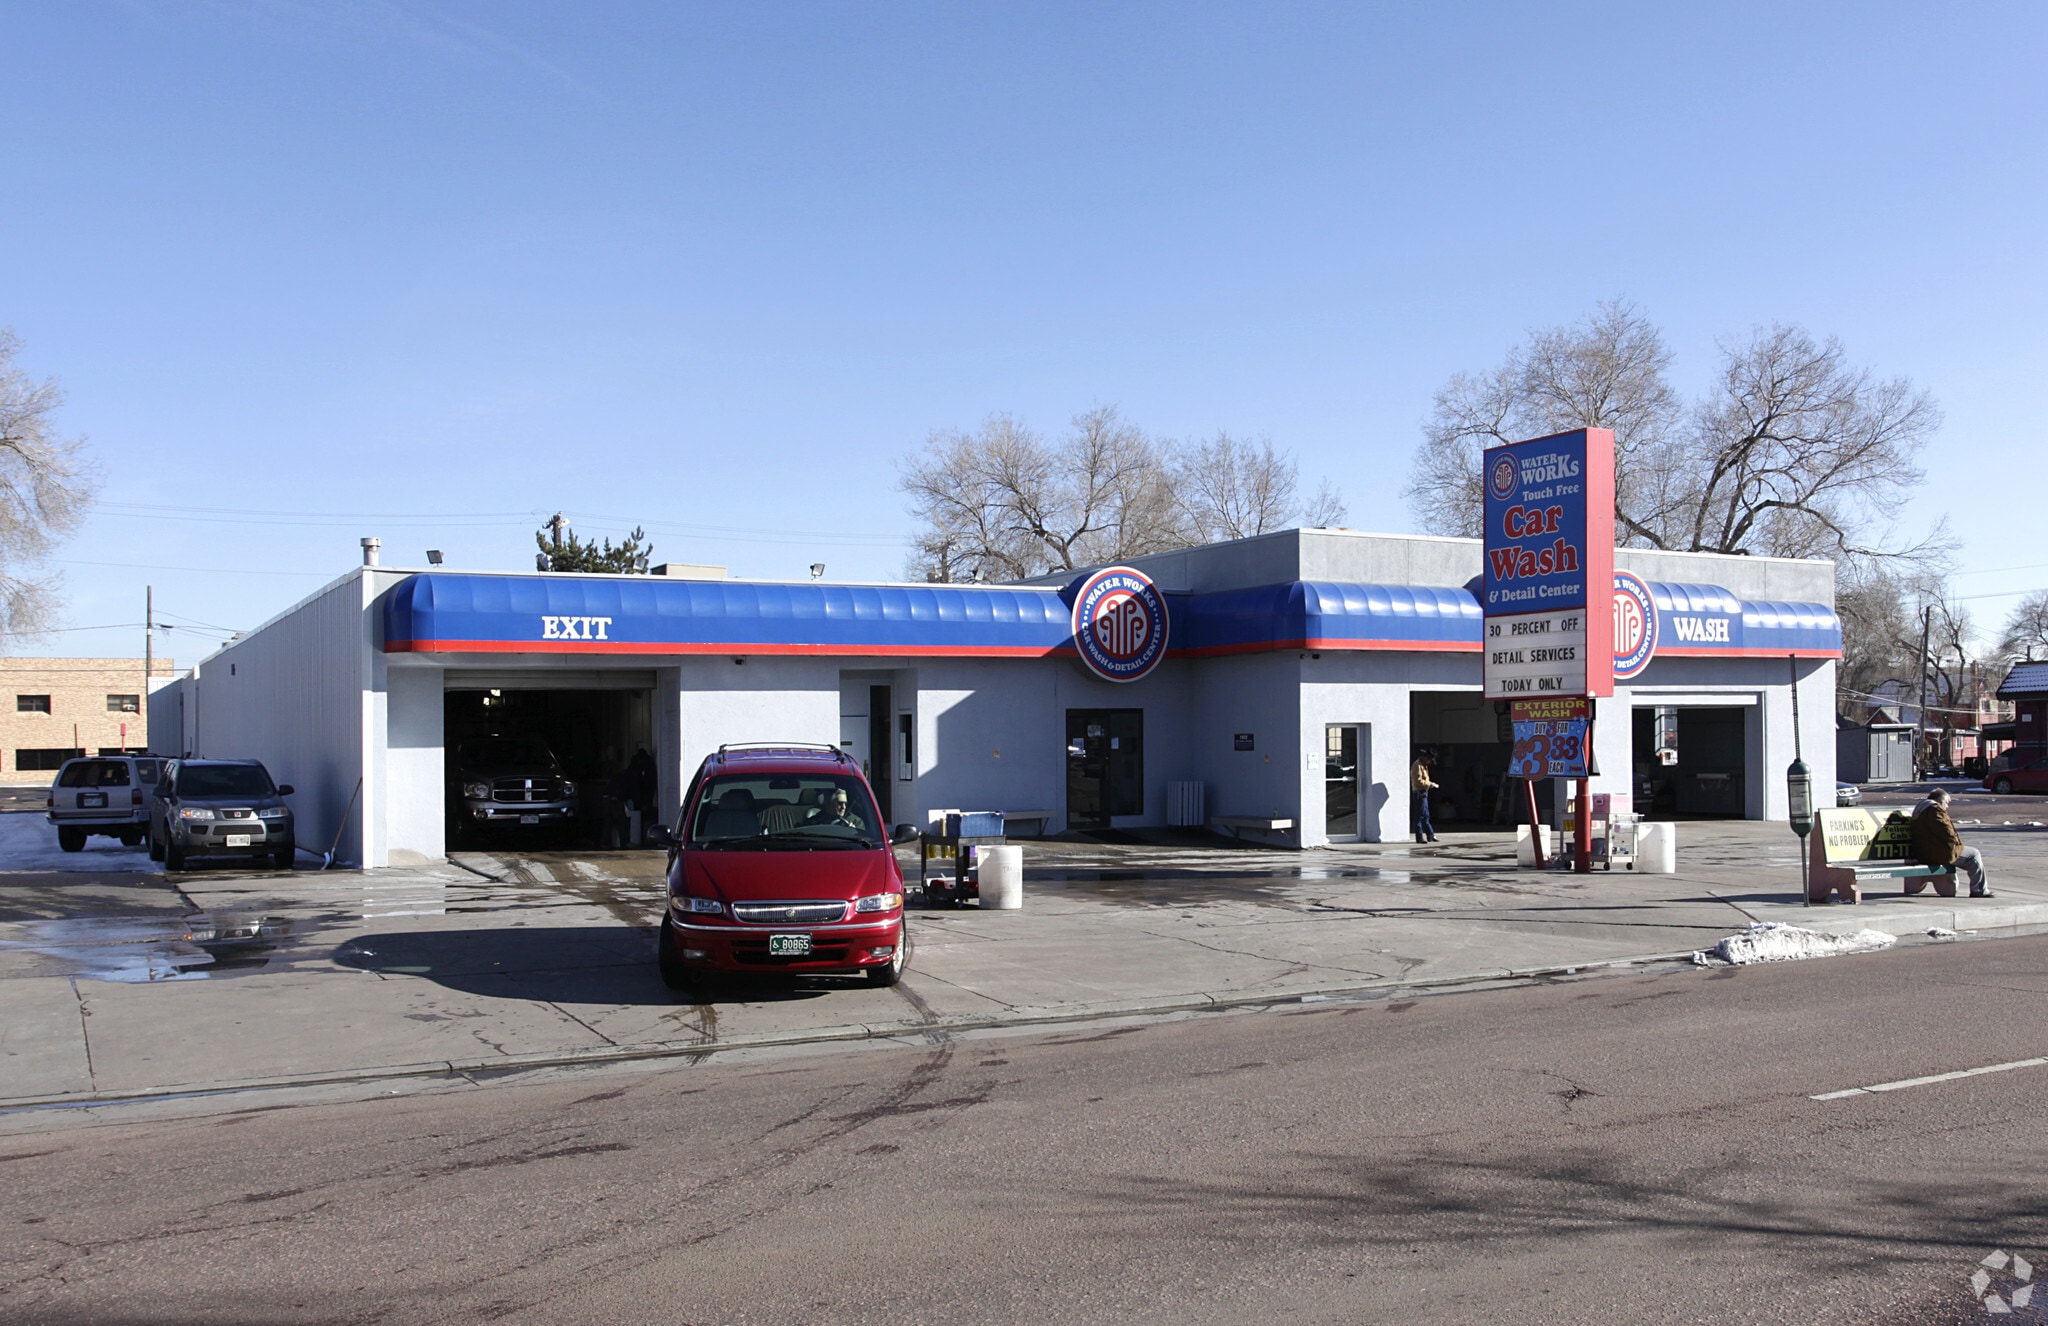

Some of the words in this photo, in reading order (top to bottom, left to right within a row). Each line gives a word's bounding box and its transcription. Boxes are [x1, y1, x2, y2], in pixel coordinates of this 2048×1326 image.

[1521, 453, 1557, 469] WATER
[1523, 487, 1552, 501] Touch
[1556, 484, 1579, 496] Free
[1504, 505, 1563, 539] Car
[1489, 537, 1578, 581] Wash
[1086, 577, 1120, 606] WATER
[1122, 577, 1156, 607] WORKS
[1489, 591, 1498, 603] &
[1502, 587, 1536, 601] Detail
[1539, 584, 1580, 596] Center
[1622, 579, 1648, 608] WORKS
[542, 616, 612, 640] EXIT
[1490, 626, 1500, 636] 30
[1512, 620, 1550, 634] PERCENT
[1562, 618, 1578, 631] OFF
[1673, 617, 1730, 642] WASH
[1082, 622, 1090, 644] CAR
[1088, 642, 1108, 666] WASH
[1108, 662, 1114, 670] &
[1114, 660, 1144, 671] DETAIL
[1143, 624, 1160, 660] CENTER
[1617, 655, 1639, 668] DETAIL
[1638, 622, 1652, 658] CENTER
[1493, 651, 1524, 664] DETAIL
[1531, 648, 1574, 662] SERVICES
[1502, 679, 1532, 691] TODAY
[1539, 677, 1562, 690] ONLY
[1515, 700, 1585, 710] EXTERIOR
[1530, 710, 1570, 718] WASH
[1535, 722, 1546, 734] BUY
[1546, 719, 1558, 737] 3
[1558, 722, 1568, 734] FOR
[1549, 762, 1564, 773] EACH
[1830, 820, 1864, 831] PARKING'S
[1828, 835, 1838, 846] NO
[1841, 835, 1870, 846] PROBLEM
[782, 940, 808, 949] 80865
